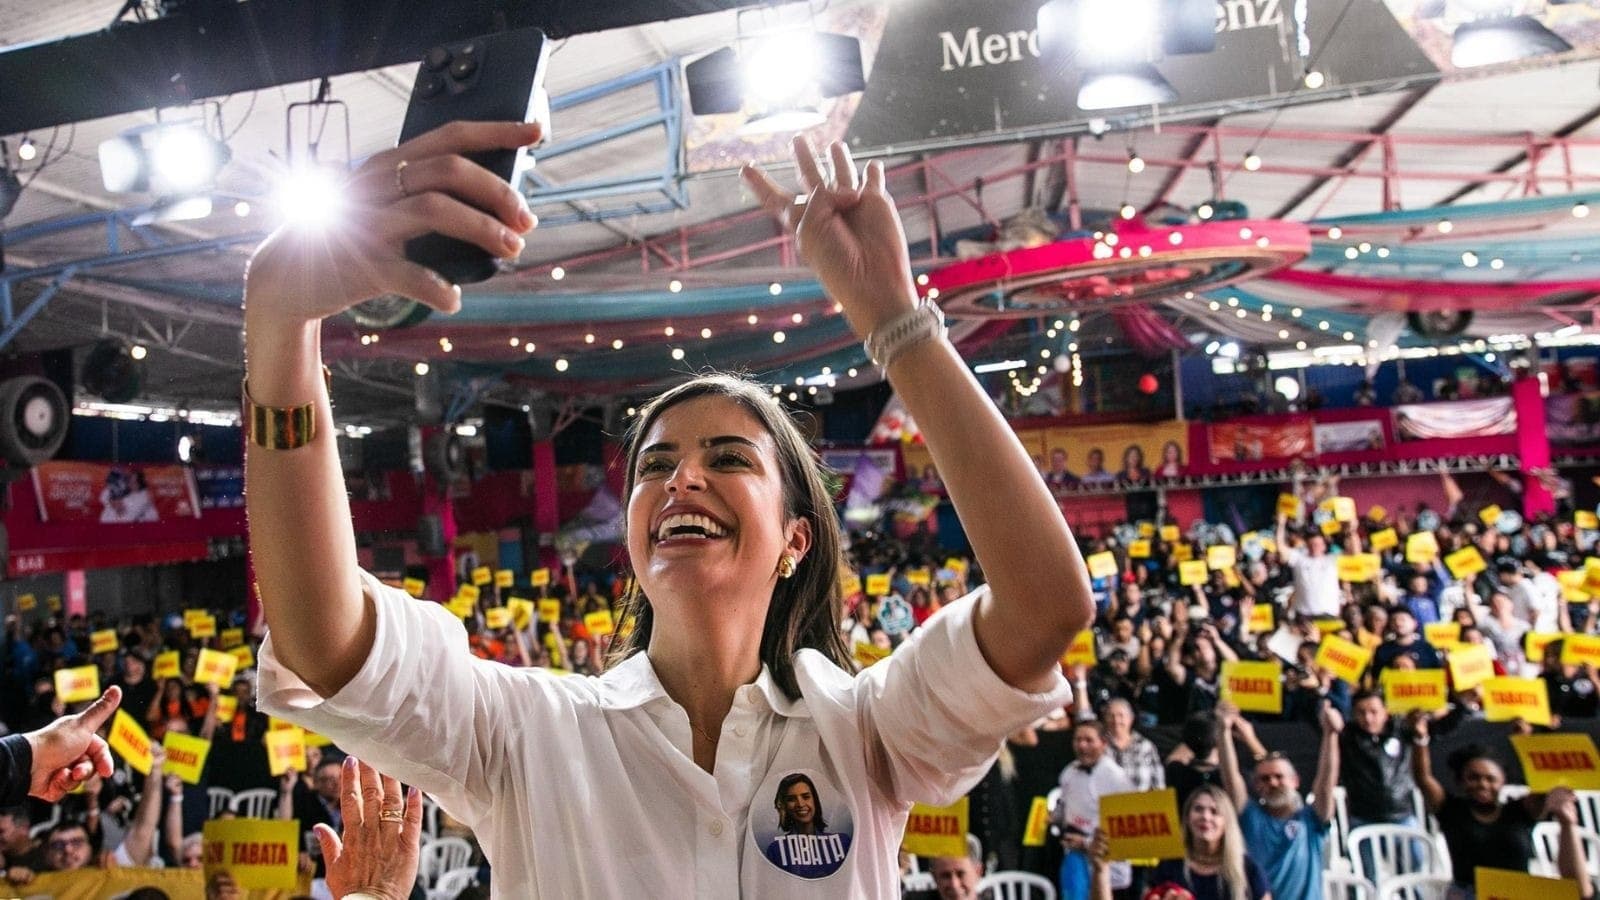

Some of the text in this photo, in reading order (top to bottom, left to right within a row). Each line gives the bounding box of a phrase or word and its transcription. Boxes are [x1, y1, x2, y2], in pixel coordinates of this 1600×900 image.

[939, 0, 1284, 71] Merc enz
[1229, 678, 1273, 695] TABATA
[1392, 683, 1439, 698] TABATA
[1491, 691, 1539, 706] TABATA
[118, 724, 149, 758] TABATA
[1528, 751, 1596, 771] TABATA
[1108, 812, 1172, 839] TABATA
[231, 842, 289, 865] TABATA
[774, 834, 846, 866] TABATA
